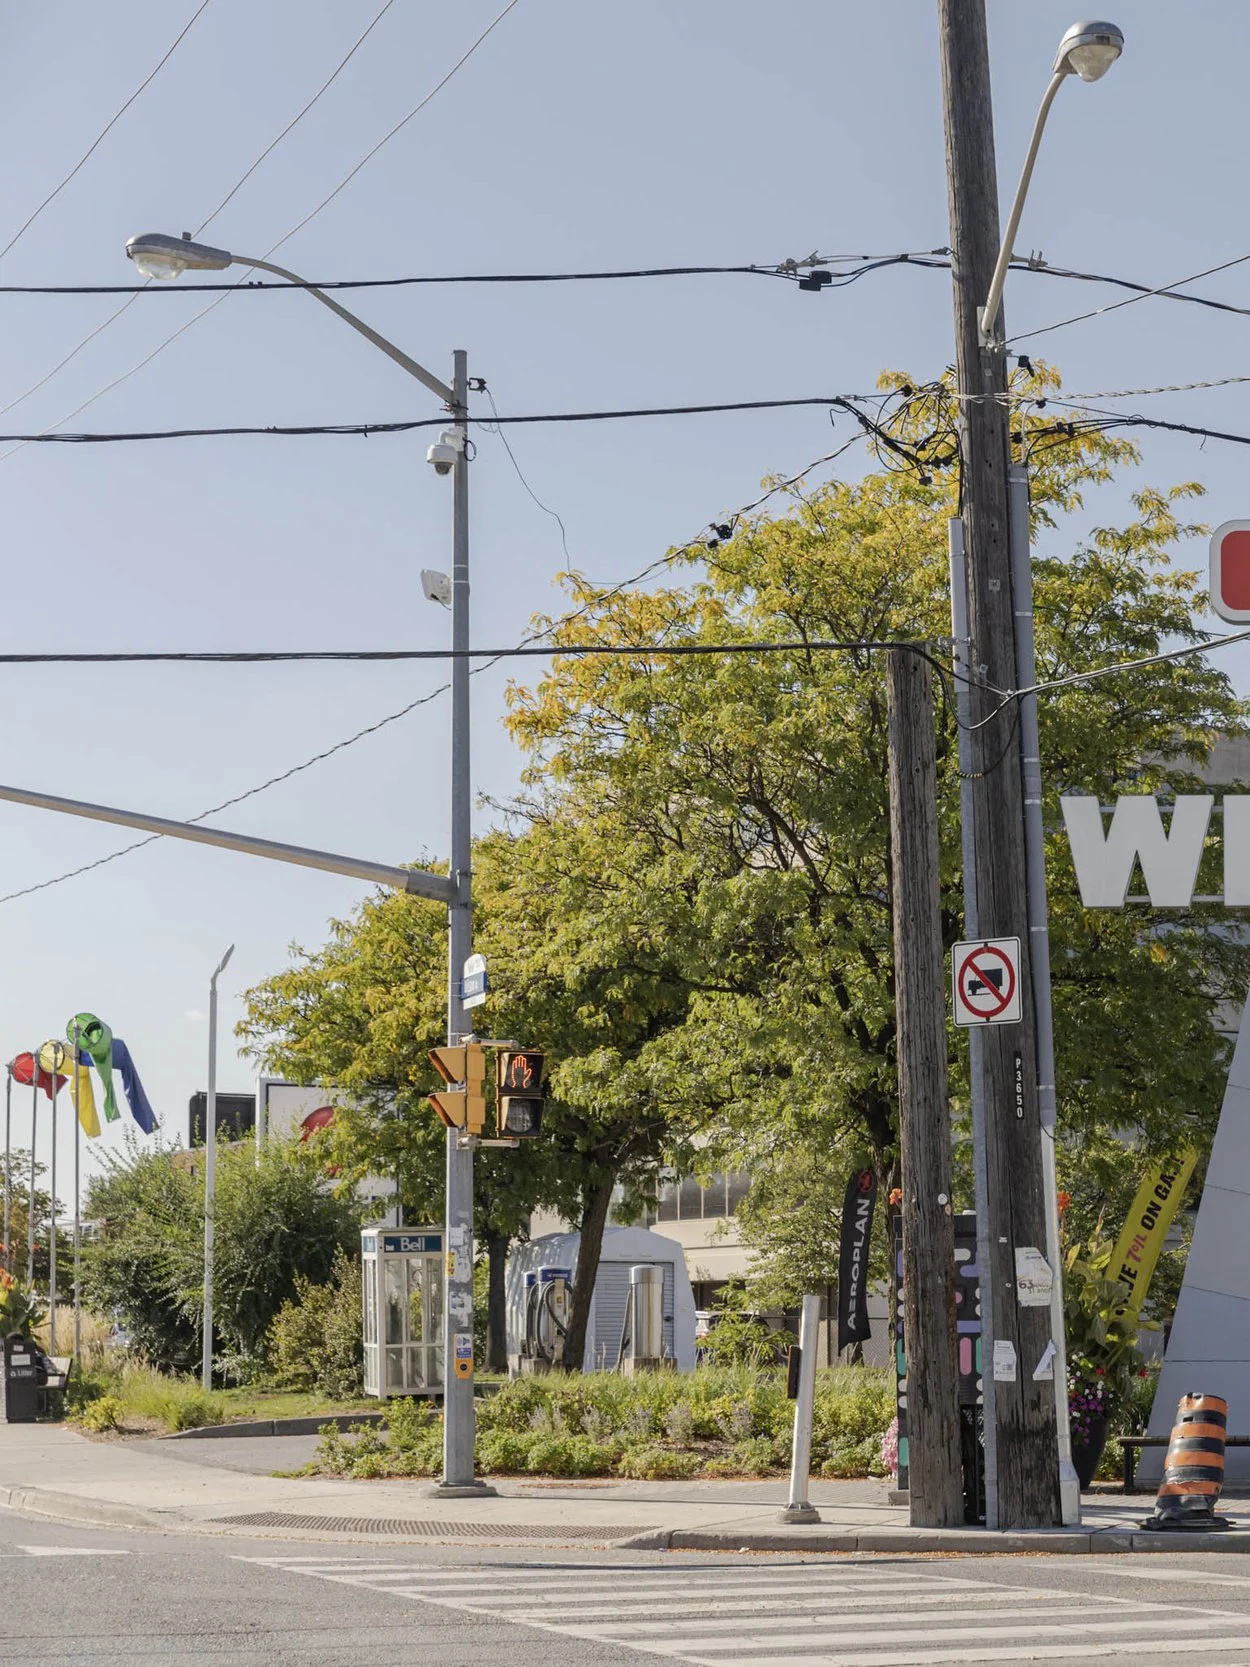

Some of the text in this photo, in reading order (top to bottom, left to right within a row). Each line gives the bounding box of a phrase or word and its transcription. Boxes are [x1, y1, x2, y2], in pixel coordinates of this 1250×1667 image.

[1015, 1057, 1023, 1118] P3650
[1140, 1204, 1162, 1231] ON
[1154, 1156, 1185, 1201] GA!
[401, 1237, 425, 1251] Bell
[847, 1198, 870, 1331] AEROPLAN
